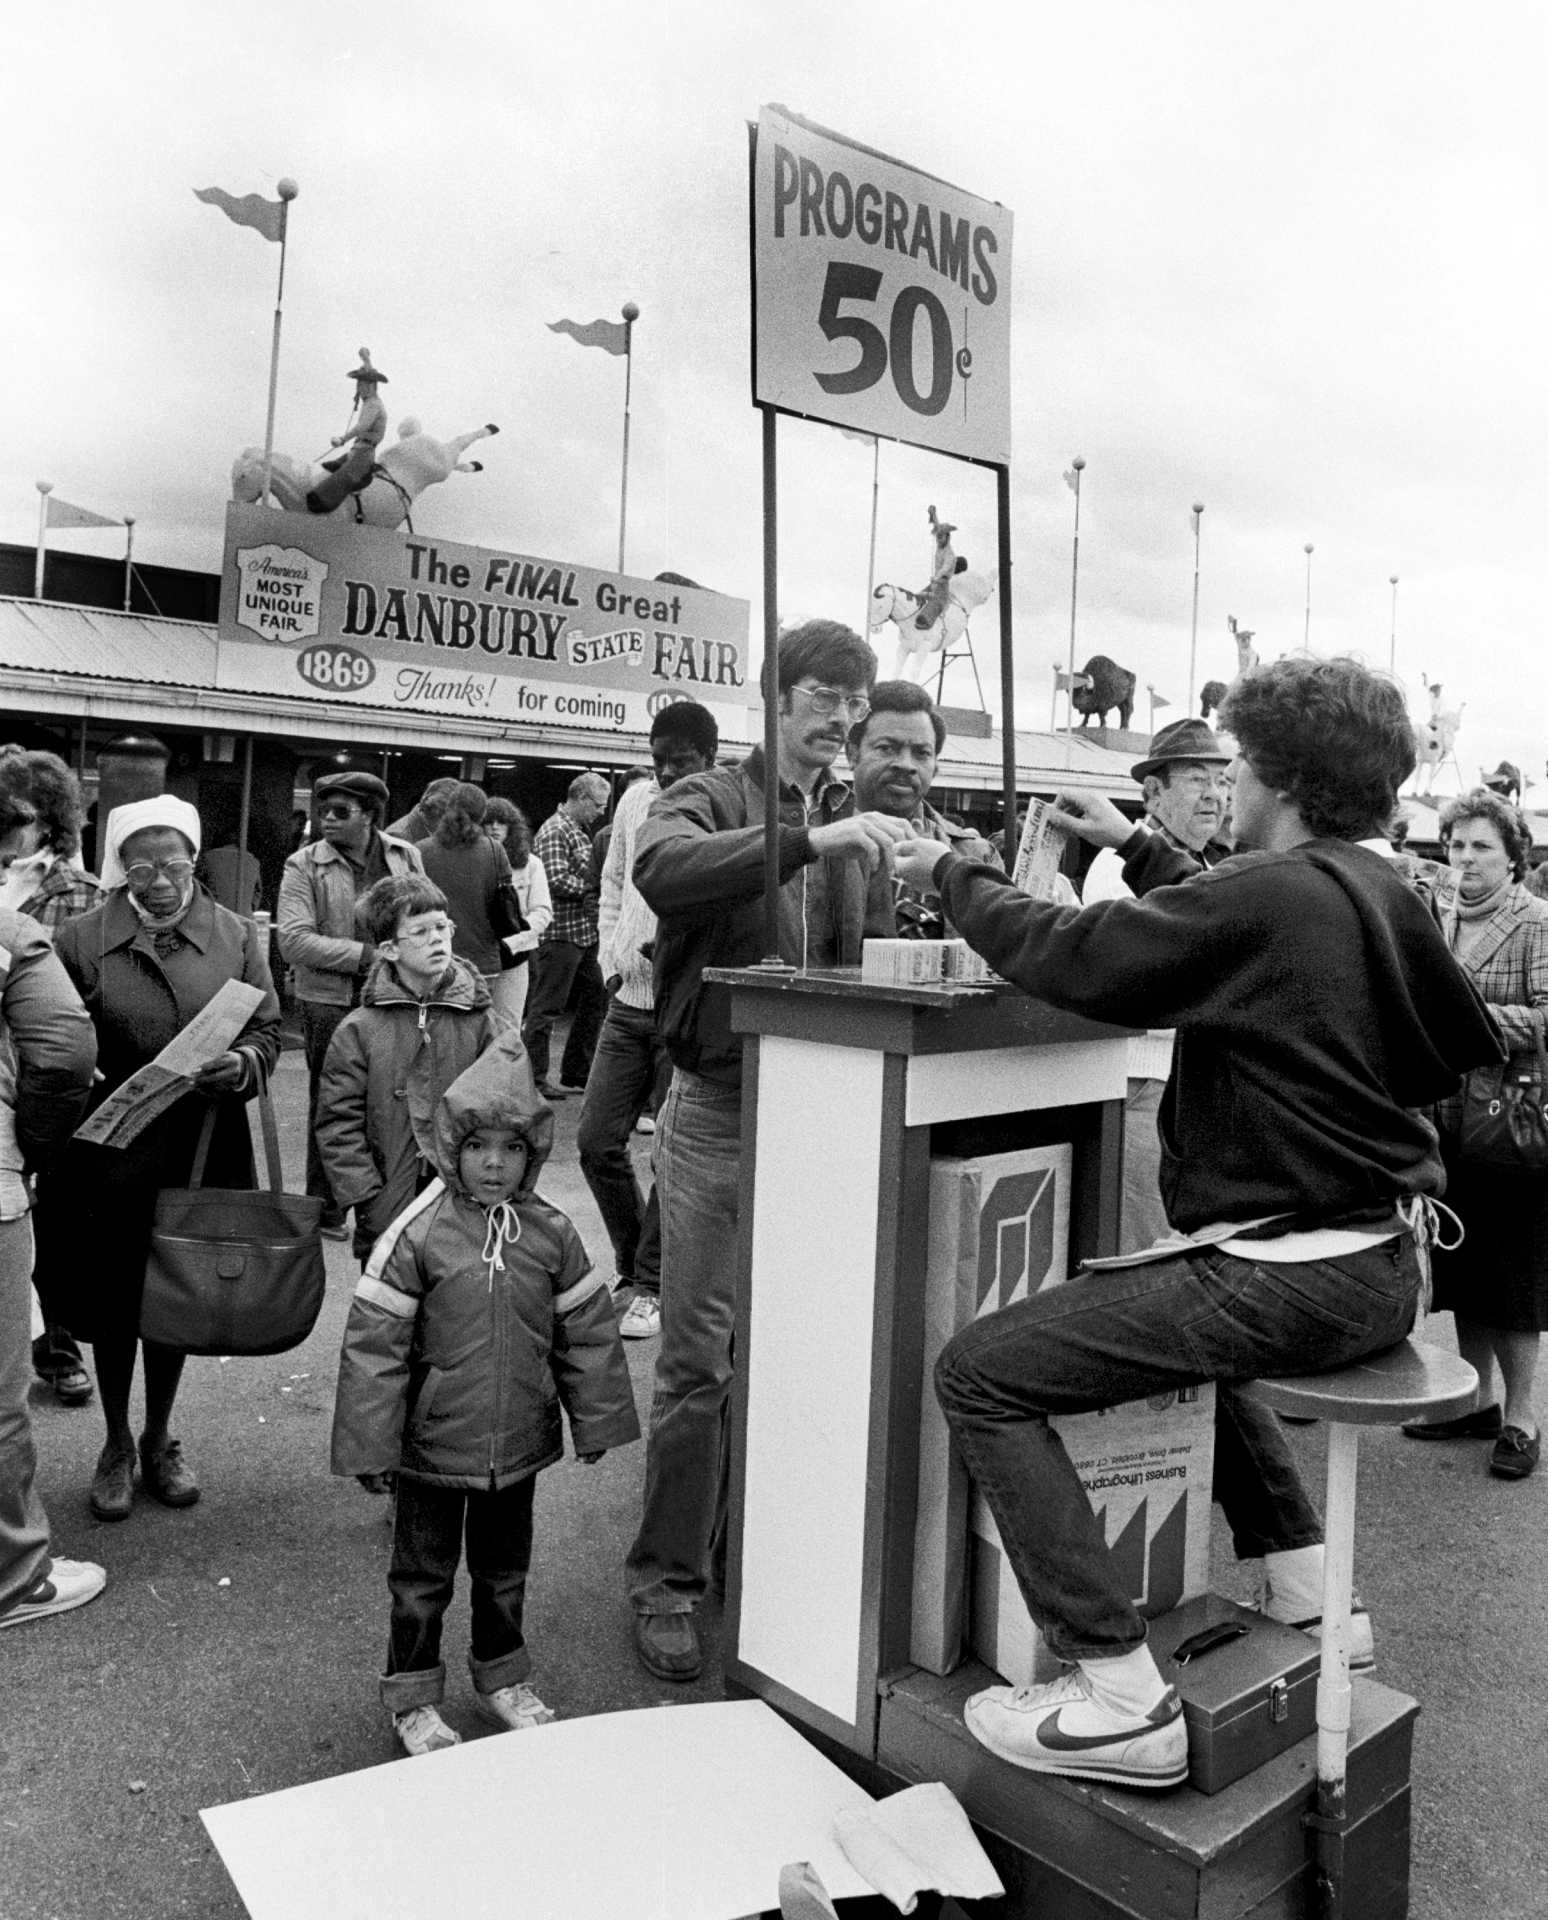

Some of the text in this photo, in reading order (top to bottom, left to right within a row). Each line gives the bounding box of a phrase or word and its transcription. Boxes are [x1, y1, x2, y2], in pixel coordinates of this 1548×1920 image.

[774, 143, 998, 306] PROGRAMS
[248, 557, 309, 580] America's
[256, 578, 304, 598] MOST
[405, 543, 682, 624] The FINAL Great
[246, 594, 314, 616] UNIQUE
[260, 613, 302, 631] FAIR
[342, 581, 744, 687] DANBURY STATE FAIR
[303, 650, 369, 687] 1869
[394, 668, 625, 725] Thanks! for coming
[1082, 1472, 1143, 1492] Lithographe
[1145, 1465, 1187, 1482] Business
